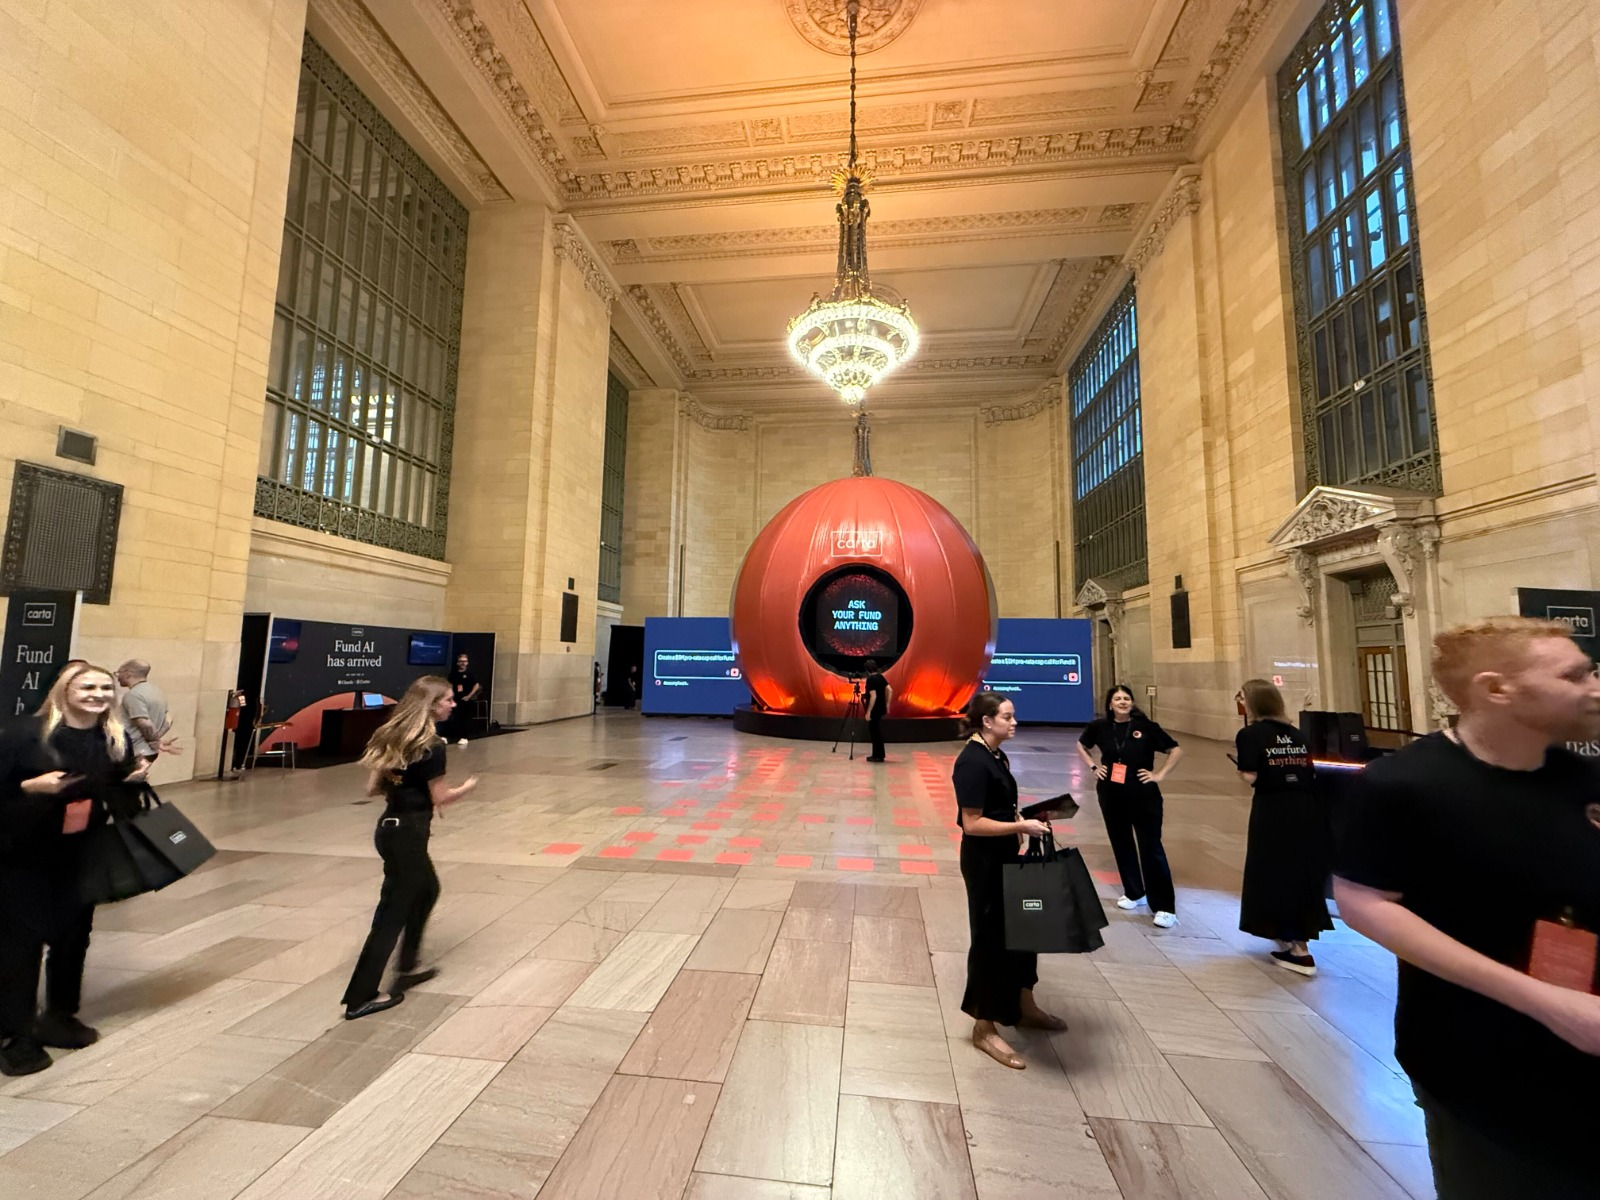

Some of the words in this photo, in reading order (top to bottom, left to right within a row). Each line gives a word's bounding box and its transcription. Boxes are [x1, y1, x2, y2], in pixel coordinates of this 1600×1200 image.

[837, 537, 876, 549] carta
[848, 600, 866, 609] ASK
[27, 609, 52, 619] carta
[832, 610, 855, 619] YOUR
[859, 611, 882, 620] FUND
[834, 621, 879, 631] ANYTHING
[335, 640, 361, 652] Fund
[362, 641, 375, 653] AI
[16, 644, 54, 664] Fund
[327, 654, 345, 667] has
[347, 655, 382, 667] arrived
[21, 671, 40, 690] AI
[1276, 734, 1293, 744] Ask
[1265, 746, 1286, 757] your
[1286, 744, 1308, 754] fund
[1269, 755, 1308, 767] anything
